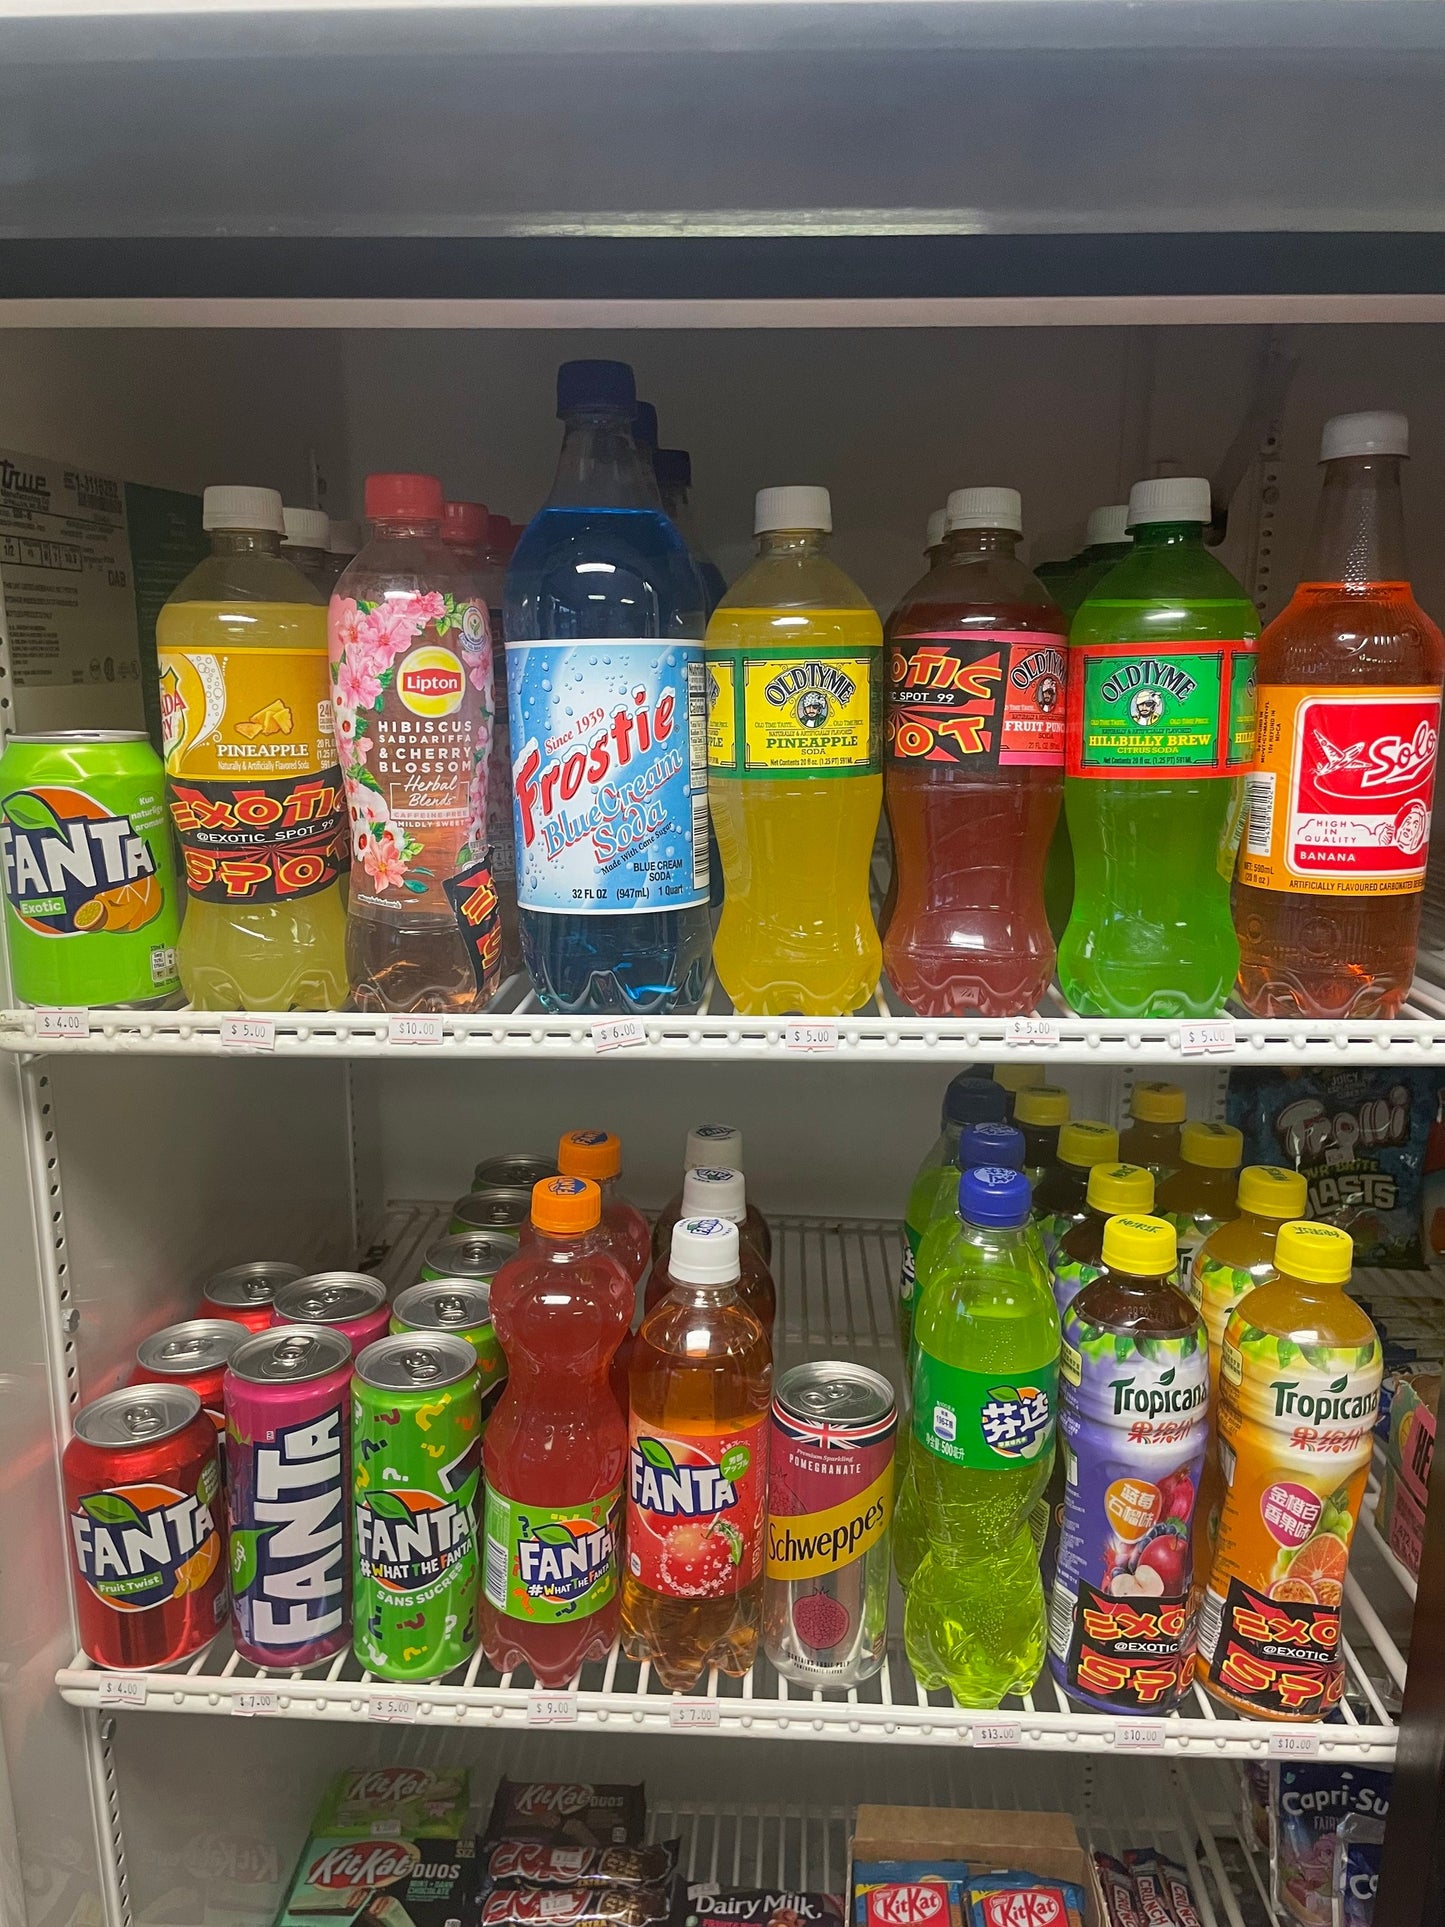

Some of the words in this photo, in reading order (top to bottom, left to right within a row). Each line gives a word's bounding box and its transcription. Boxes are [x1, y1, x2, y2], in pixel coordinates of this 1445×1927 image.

[406, 676, 459, 693] Lipton
[899, 692, 930, 702] SPOT
[936, 693, 955, 703] 99
[378, 720, 472, 733] HIBISCUS
[544, 731, 575, 754] Since
[575, 708, 606, 735] 1939
[1004, 721, 1044, 732] FRUIT
[378, 734, 472, 743] SABDARIFFA
[766, 736, 858, 749] PINEAPPLE
[1089, 735, 1162, 746] HILLBILLY
[1167, 734, 1212, 746] BREW
[216, 744, 309, 757] PINEAPPLE
[378, 748, 392, 759] &
[395, 747, 472, 759] CHERRY
[1361, 719, 1438, 789] Solo
[218, 760, 242, 770] Naturally
[248, 760, 275, 770] Artificially
[275, 760, 297, 769] Flavored
[297, 760, 309, 769] Soda
[379, 761, 472, 773] BLOSSOM
[513, 684, 676, 848] Frostie
[403, 774, 458, 792] Herbal
[409, 793, 457, 807] Blends
[541, 808, 602, 861] Blue
[596, 748, 684, 820] Cream
[275, 825, 314, 841] SPOT
[321, 819, 334, 829] 99
[592, 799, 669, 864] Soda
[1316, 820, 1348, 828] HIGH
[1304, 835, 1357, 843] QUALITY
[601, 860, 622, 875] Made
[622, 847, 639, 864] With
[638, 836, 655, 853] Cane
[654, 821, 674, 842] Sugar
[0, 820, 154, 894] FANTA
[1299, 850, 1356, 862] BANANA
[633, 862, 656, 872] BLUE
[656, 858, 683, 870] CREAM
[649, 872, 672, 882] SODA
[572, 889, 583, 899] 32
[584, 889, 595, 899] FL
[596, 889, 608, 899] OZ
[616, 888, 650, 900] (947mL)
[664, 885, 683, 896] Quart
[1289, 879, 1334, 891] ARTIFICIALLY
[1336, 880, 1378, 891] FLAVOURED
[21, 901, 62, 914] Exotic
[44, 1016, 50, 1029] $
[56, 1016, 80, 1029] 4.00
[1014, 1022, 1020, 1033] $
[1025, 1021, 1050, 1034] 5.00
[230, 1023, 237, 1036] $
[242, 1024, 266, 1038] 5.00
[600, 1030, 608, 1040] $
[612, 1023, 637, 1038] 6.00
[794, 1031, 800, 1042] $
[806, 1030, 829, 1042] 5.00
[1188, 1031, 1195, 1043] $
[1277, 1086, 1409, 1157] Trolli
[1108, 1376, 1208, 1420] Tropicana
[1269, 1380, 1379, 1426] Tropicana
[982, 1392, 1049, 1444] 芬达
[1127, 1418, 1195, 1444] 果缤纷
[1289, 1426, 1365, 1454] 果缤纷
[796, 1448, 823, 1460] Premium
[823, 1455, 854, 1463] Sparkling
[789, 1453, 862, 1475] POMEGRANATE
[631, 1449, 735, 1513] FANTA
[1268, 1485, 1322, 1522] 金橙百
[1108, 1494, 1157, 1529] 石榴味
[252, 1410, 343, 1644] FANTA
[1264, 1502, 1313, 1540] 香果味
[71, 1495, 214, 1576] FANTA
[768, 1495, 885, 1563] Schweppes
[411, 1559, 440, 1577] THE
[440, 1541, 473, 1570] FANTA
[100, 1582, 126, 1593] Fruit
[126, 1575, 160, 1590] Twist
[376, 1589, 414, 1607] SANS
[415, 1562, 464, 1604] SUCRES
[572, 1577, 589, 1590] THE
[1114, 1642, 1179, 1653] @EXOTIC
[1262, 1645, 1329, 1661] @EXOTIC
[106, 1683, 112, 1693] $
[117, 1683, 138, 1695] 4.00
[249, 1695, 271, 1707] 7.00
[377, 1701, 382, 1711] $
[387, 1701, 409, 1713] 5.00
[536, 1703, 542, 1713] $
[547, 1703, 569, 1714] 9.00
[679, 1711, 685, 1720] $
[689, 1709, 712, 1721] 7.00
[1281, 1784, 1390, 1816] Capri-Su
[412, 1864, 462, 1879] DUOS
[696, 1895, 762, 1919] Dairy
[763, 1891, 823, 1919] Milk
[1138, 1879, 1169, 1926] CRUNCH
